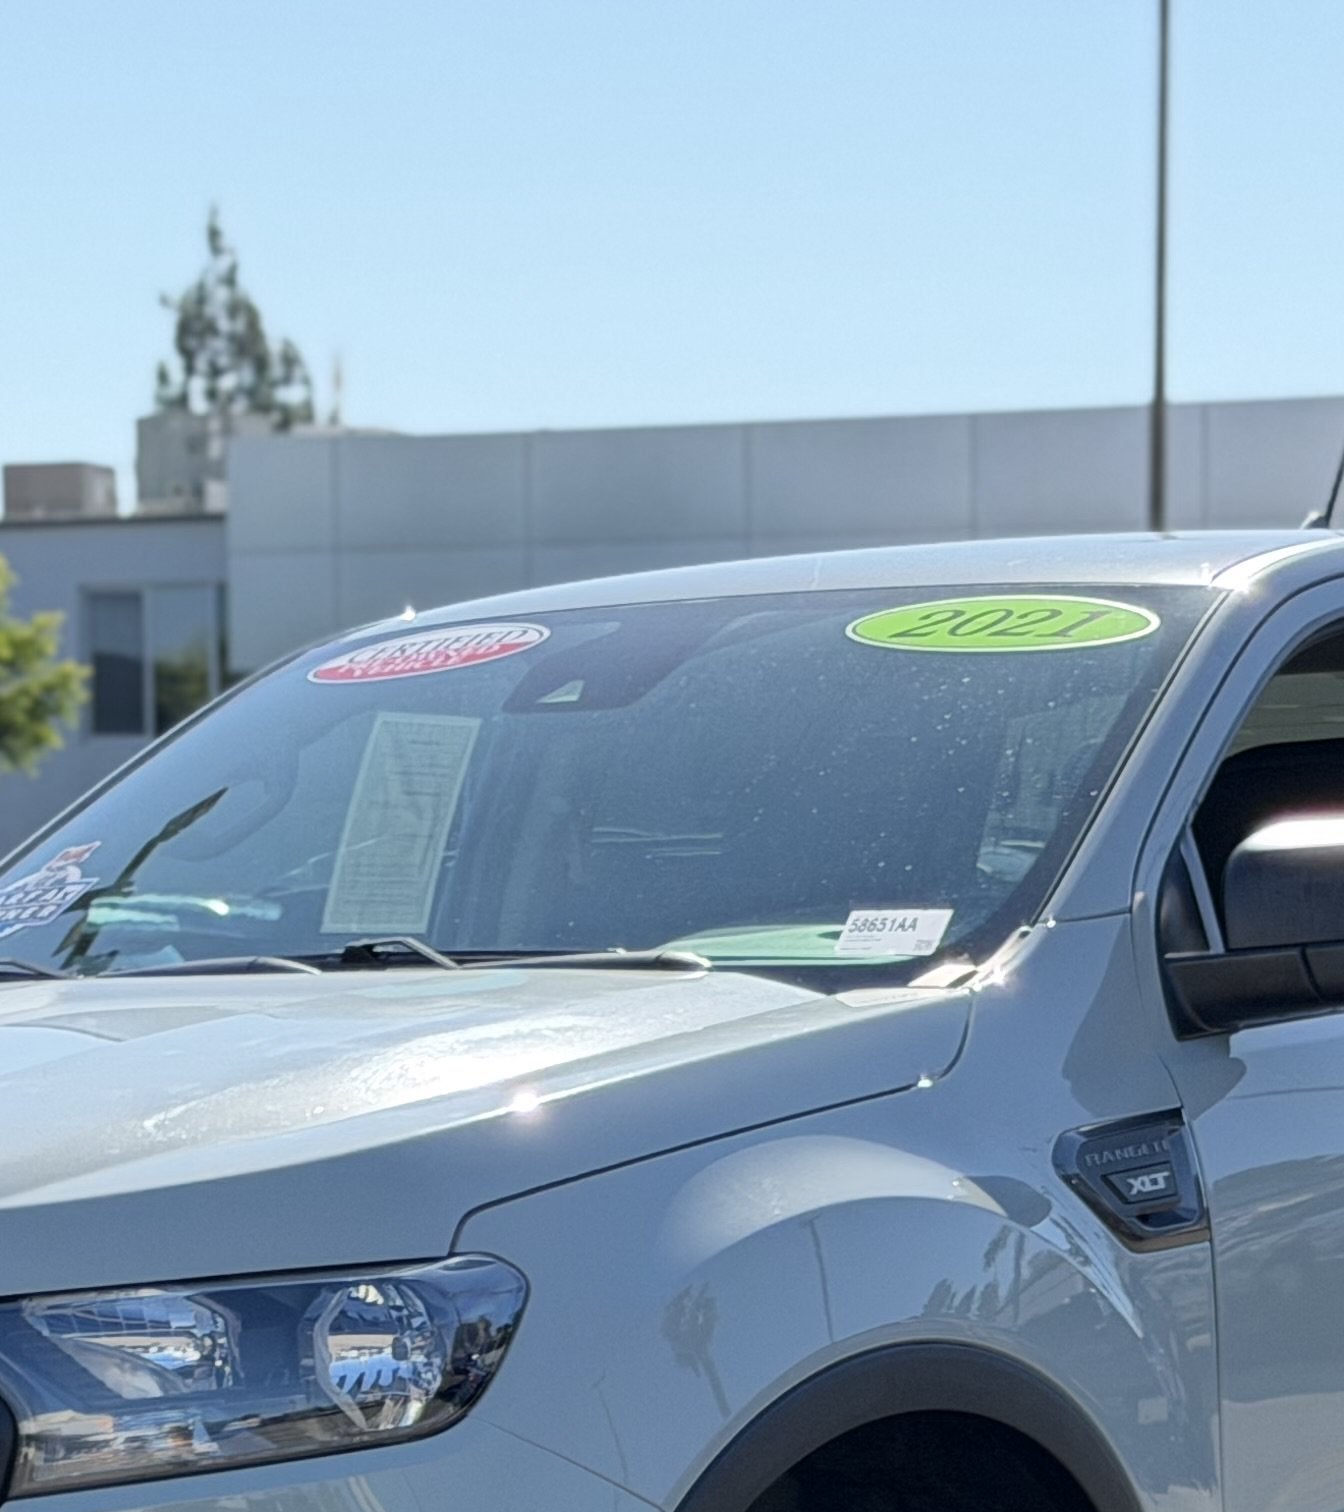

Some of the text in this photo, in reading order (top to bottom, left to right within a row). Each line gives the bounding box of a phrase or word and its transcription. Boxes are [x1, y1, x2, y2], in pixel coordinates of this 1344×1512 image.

[887, 608, 1112, 639] 2021
[346, 629, 530, 664] CERTIFIED
[847, 917, 918, 934] 58651AA
[1126, 1171, 1171, 1196] XLT
